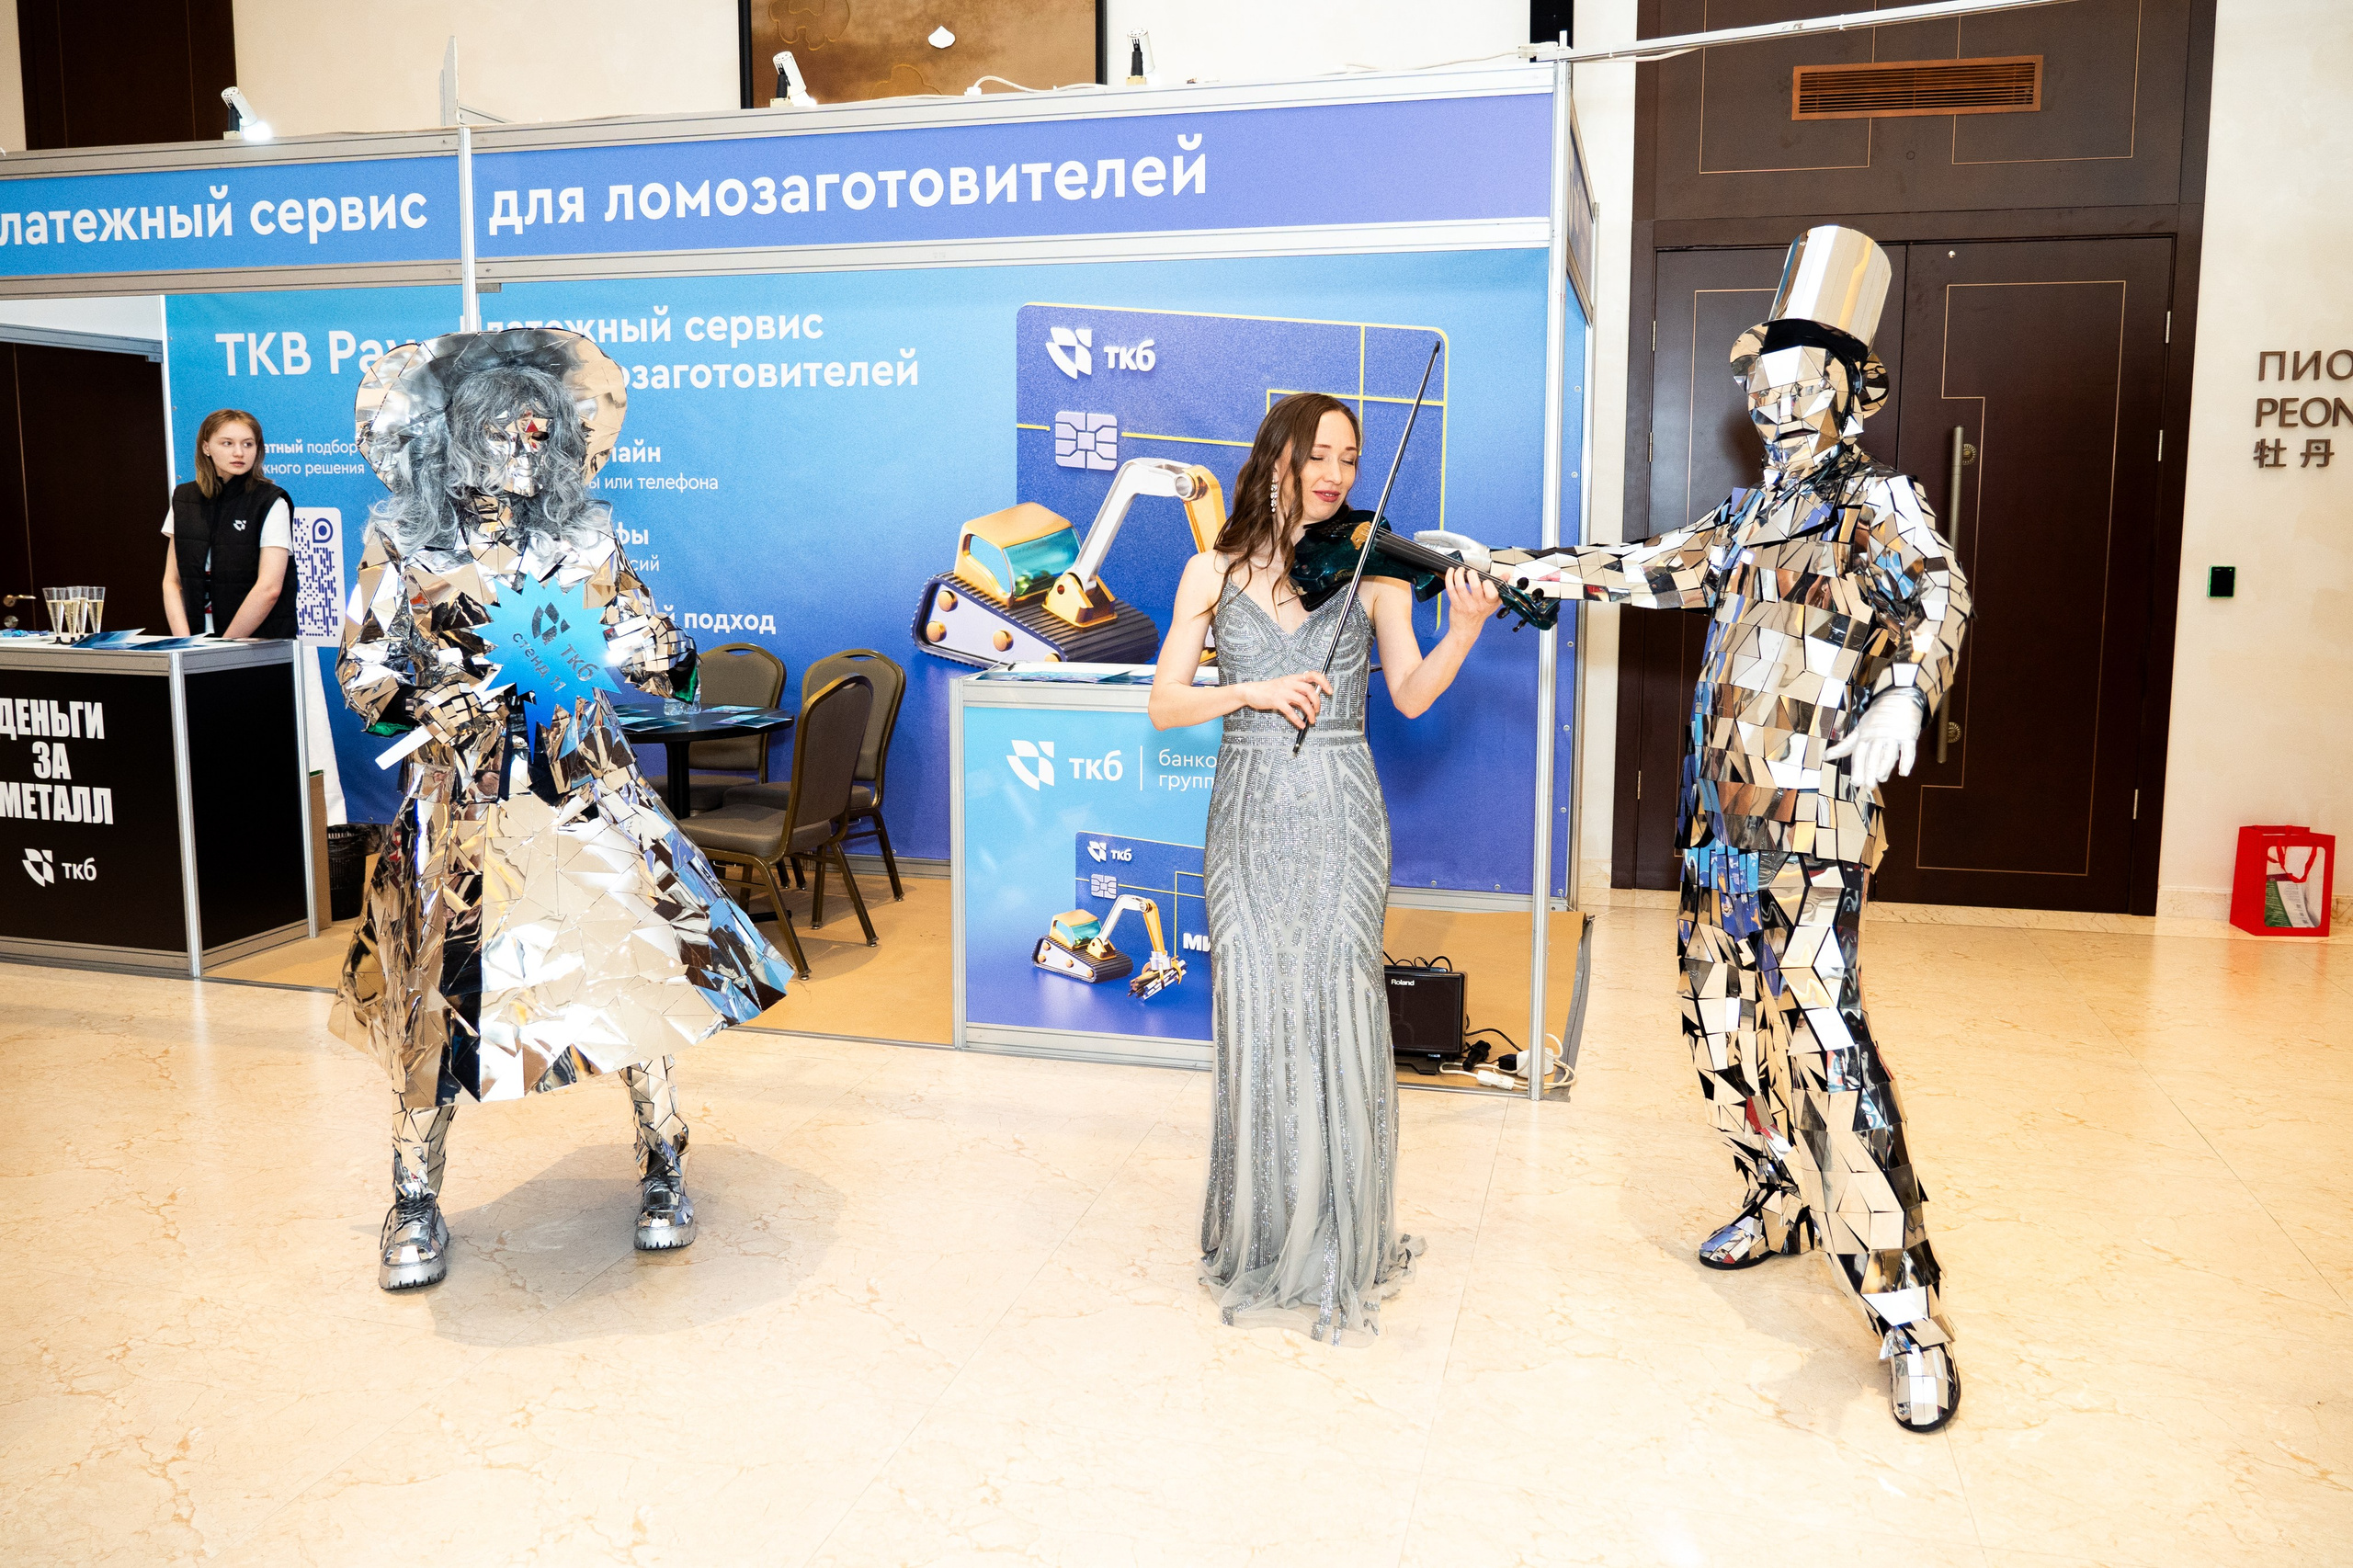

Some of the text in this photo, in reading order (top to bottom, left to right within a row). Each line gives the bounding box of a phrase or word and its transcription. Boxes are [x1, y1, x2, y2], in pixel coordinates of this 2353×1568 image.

[489, 132, 1206, 236] для ломозаготовителей
[0, 185, 428, 245] латежный сервис
[685, 313, 824, 348] сервис
[328, 331, 416, 375] Pa
[1104, 338, 1156, 372] ткб
[2258, 349, 2353, 381] ПИО
[2255, 397, 2353, 427] PEON
[307, 439, 358, 456] подбор
[2253, 438, 2335, 468] 牡丹
[305, 463, 365, 477] решения
[605, 477, 633, 490] или
[637, 472, 719, 494] телефона
[684, 612, 777, 634] подход
[512, 632, 566, 693] стенд 11
[561, 643, 600, 682] ткб
[0, 698, 105, 740] ДЕНЬГИ
[32, 741, 72, 779] ЗА
[1069, 750, 1123, 781] ткб
[1159, 748, 1217, 768] банко
[0, 781, 114, 824] МЕТАЛЛ
[62, 857, 97, 881] ткб
[1110, 848, 1132, 862] ткб
[1391, 978, 1415, 986] Roland
